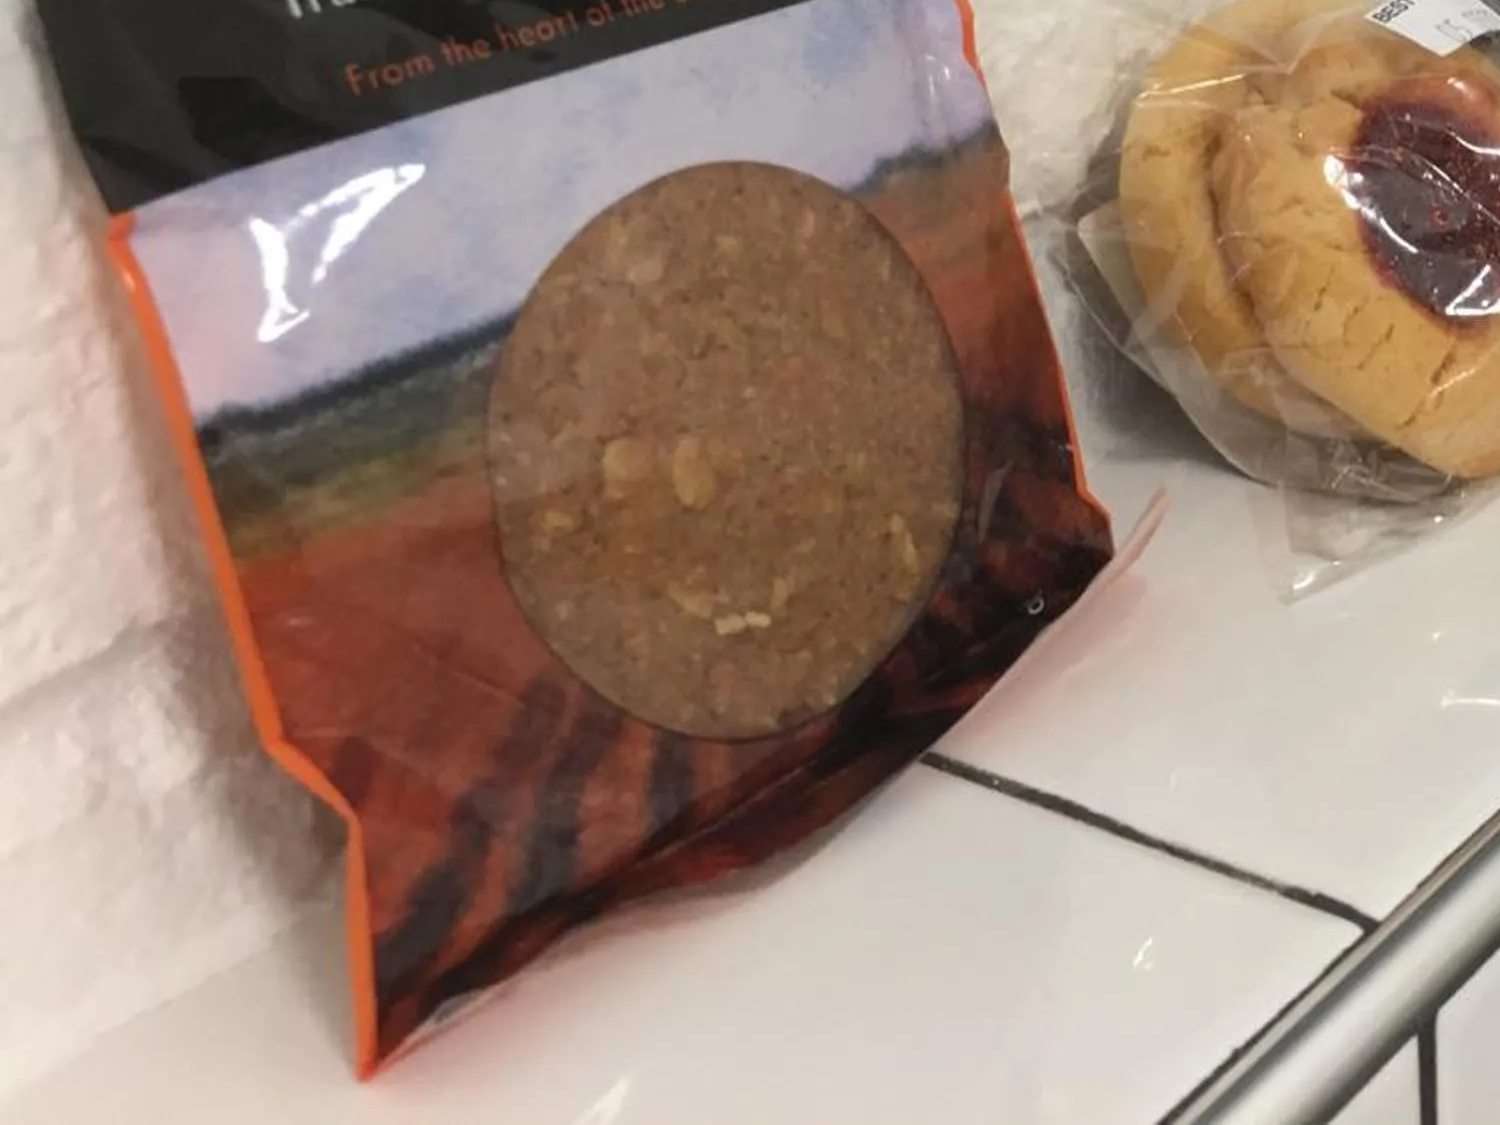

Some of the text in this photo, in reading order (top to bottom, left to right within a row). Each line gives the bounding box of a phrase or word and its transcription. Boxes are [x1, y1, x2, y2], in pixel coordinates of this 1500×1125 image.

[346, 45, 436, 96] From
[440, 34, 492, 69] the
[499, 5, 581, 55] heart
